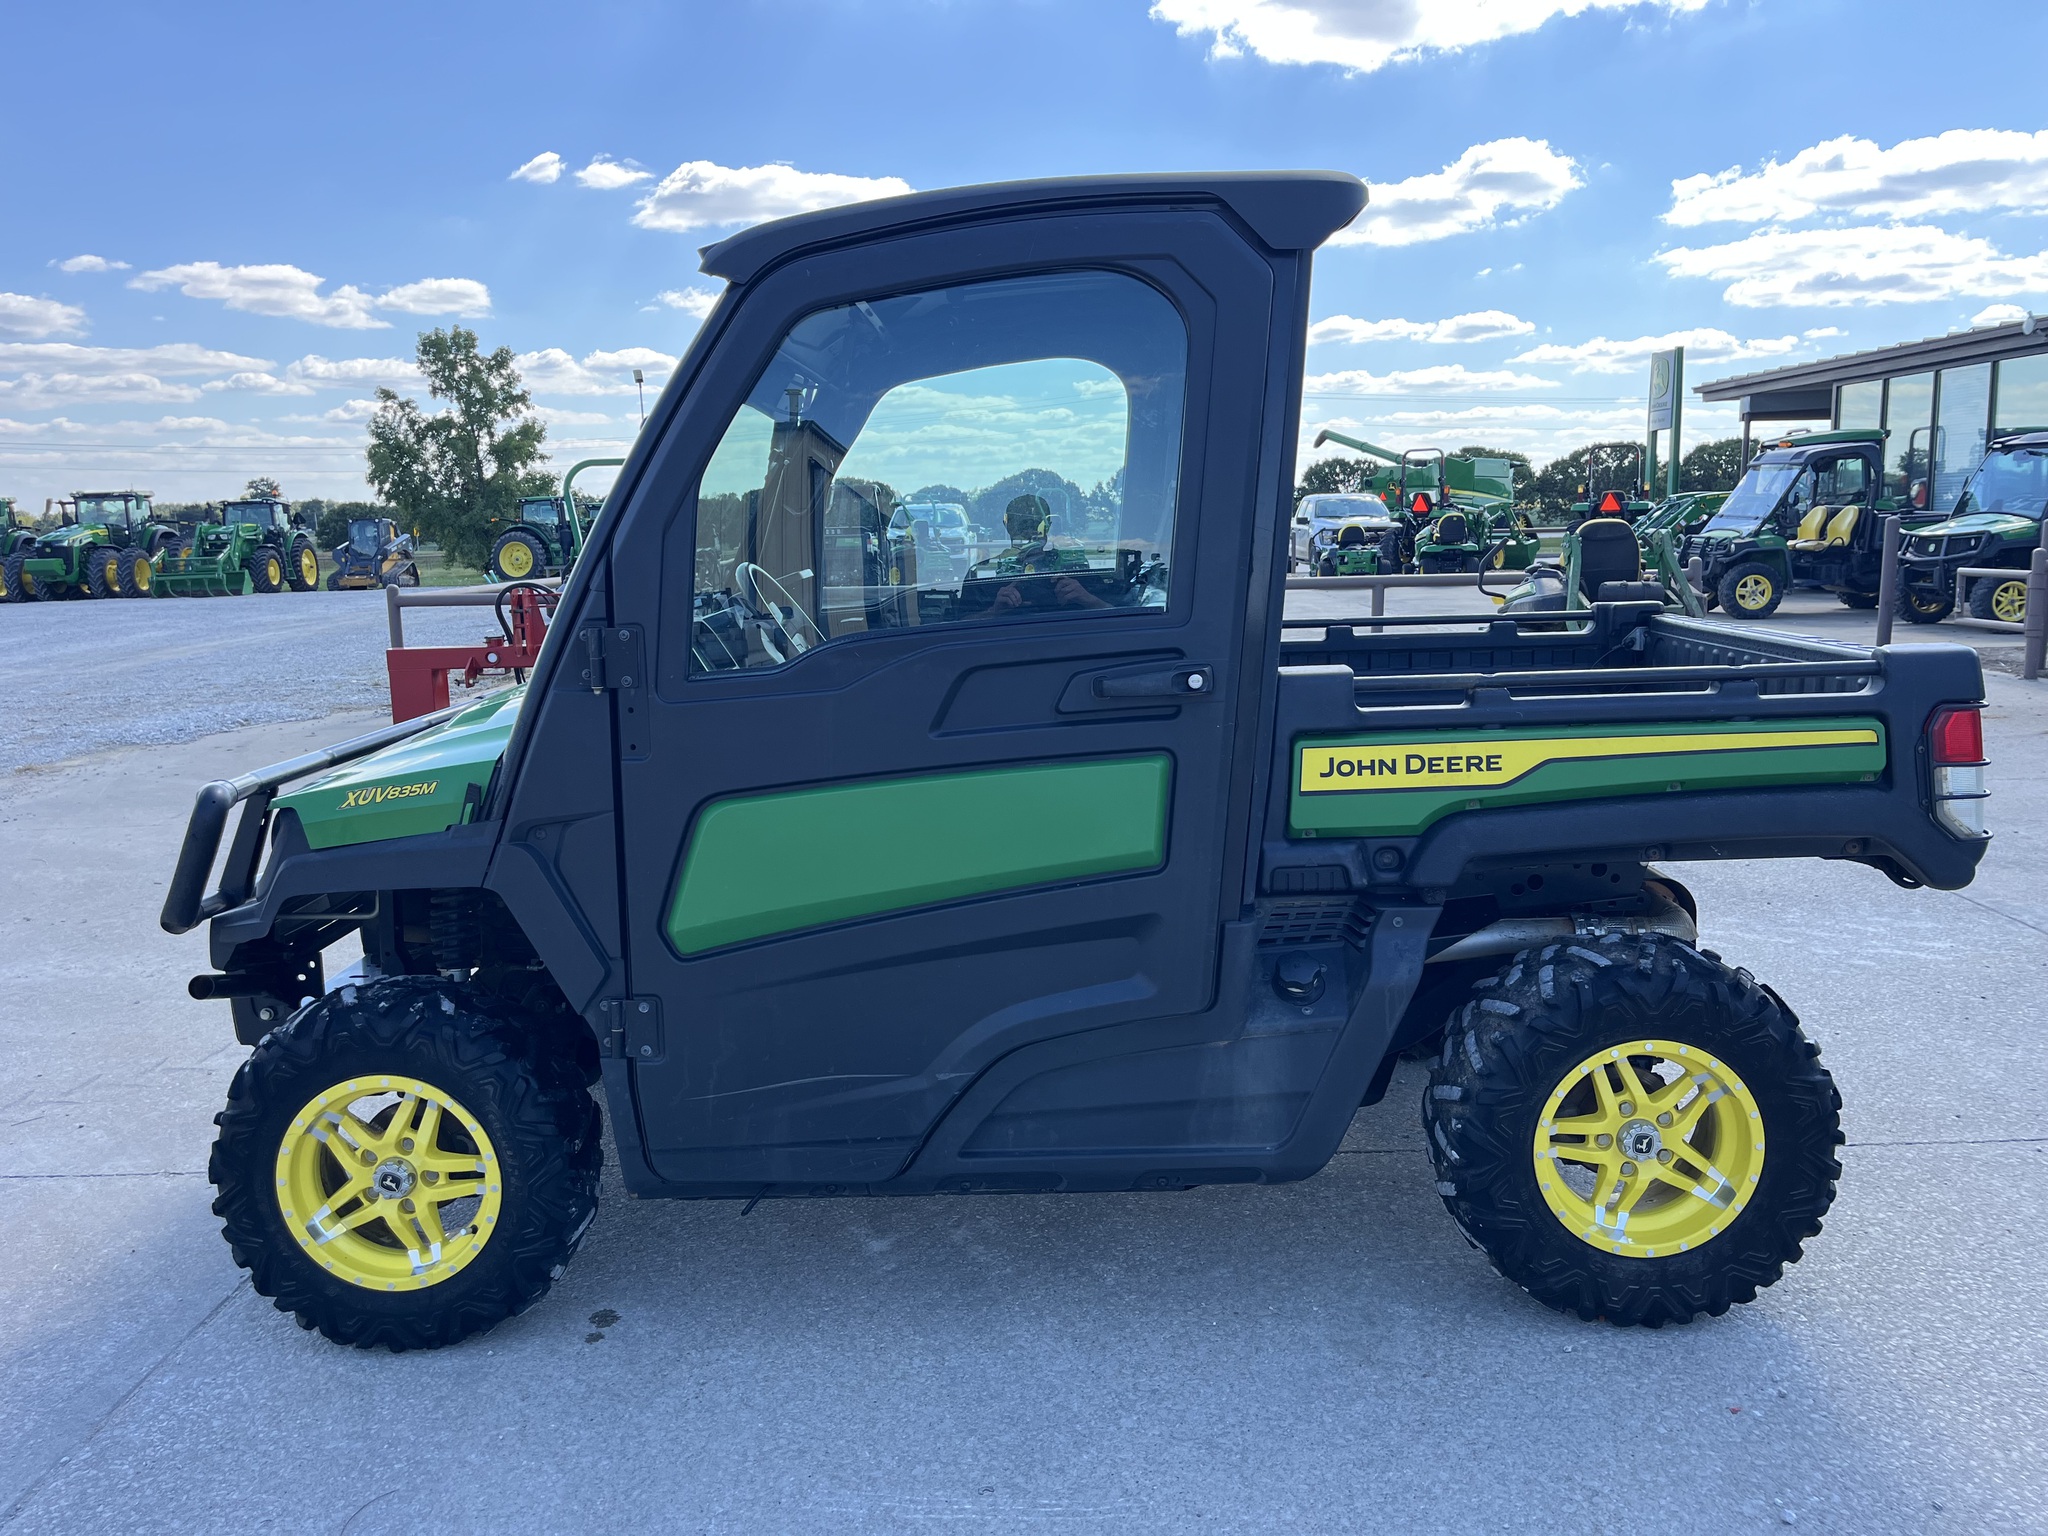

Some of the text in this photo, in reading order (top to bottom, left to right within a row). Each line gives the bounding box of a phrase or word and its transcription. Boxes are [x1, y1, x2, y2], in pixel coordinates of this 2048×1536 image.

[1319, 754, 1503, 778] JOHN DEERE
[340, 780, 438, 809] XUV835M
